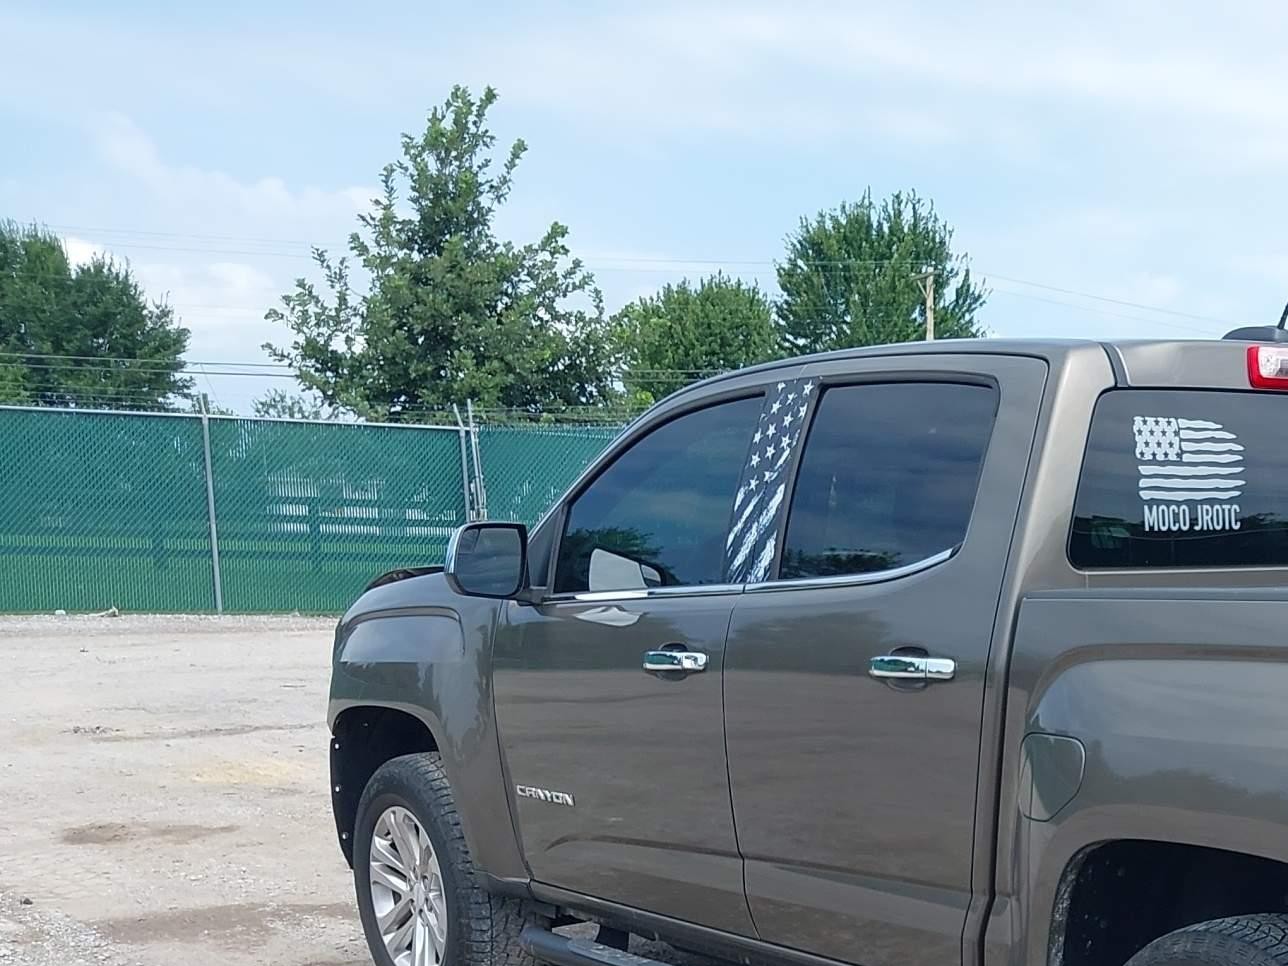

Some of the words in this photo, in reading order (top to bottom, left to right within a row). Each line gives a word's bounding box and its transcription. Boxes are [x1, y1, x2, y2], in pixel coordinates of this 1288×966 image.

[1144, 504, 1190, 532] MOCO
[1193, 503, 1241, 531] JROTC
[516, 784, 575, 807] CANYON
